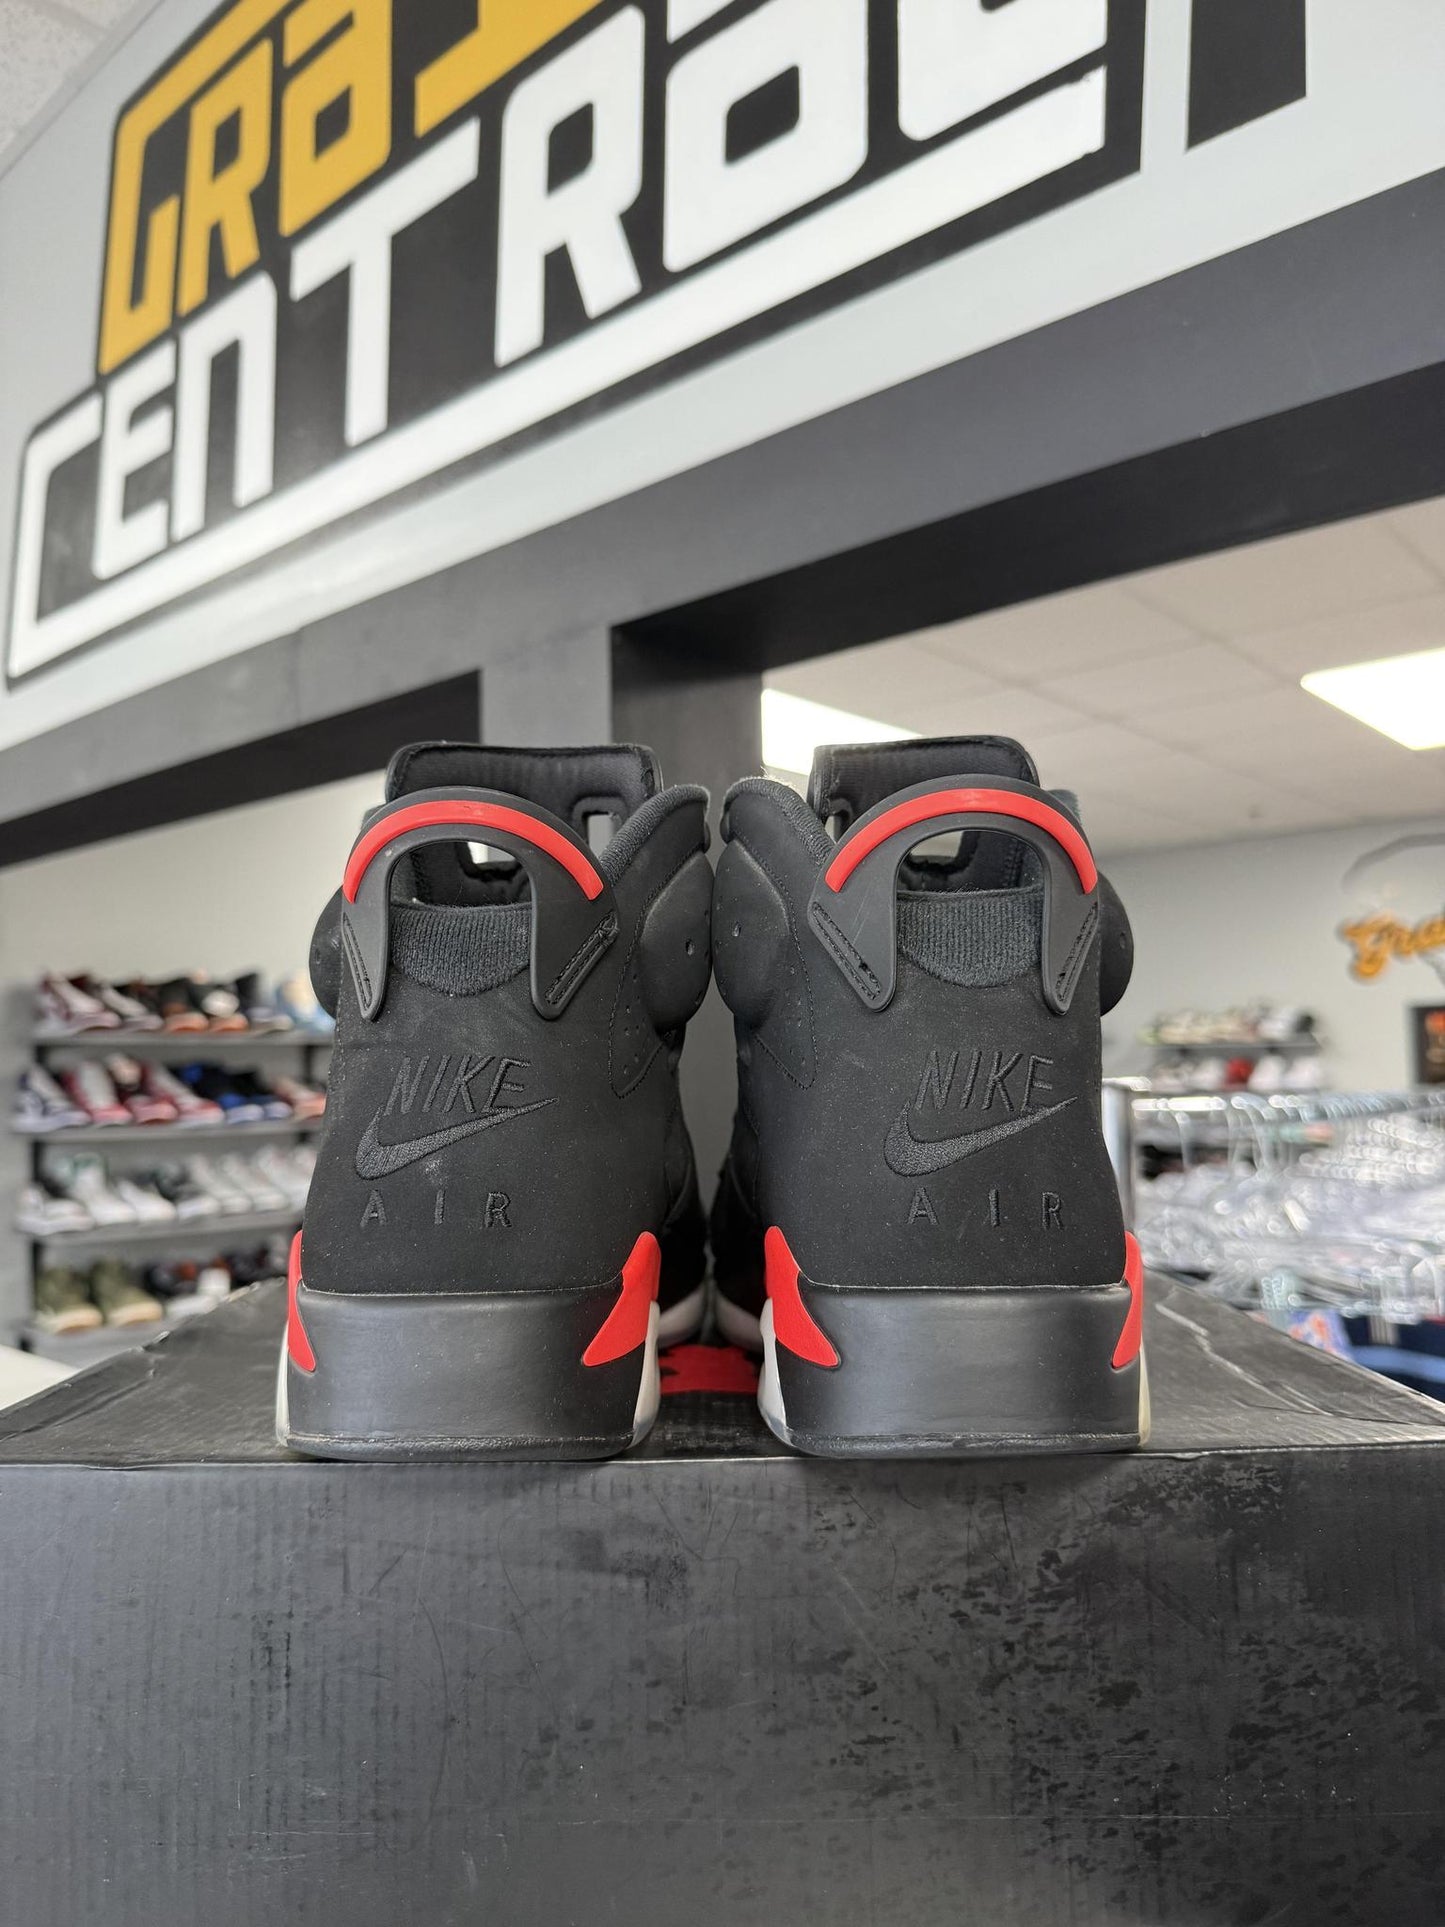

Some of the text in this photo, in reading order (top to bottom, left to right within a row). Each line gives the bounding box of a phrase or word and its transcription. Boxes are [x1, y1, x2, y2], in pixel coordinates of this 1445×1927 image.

[385, 1054, 531, 1115] NIKE
[914, 1050, 1053, 1112] NIKE
[361, 1189, 512, 1228] AIR
[907, 1187, 1065, 1229] AIR
